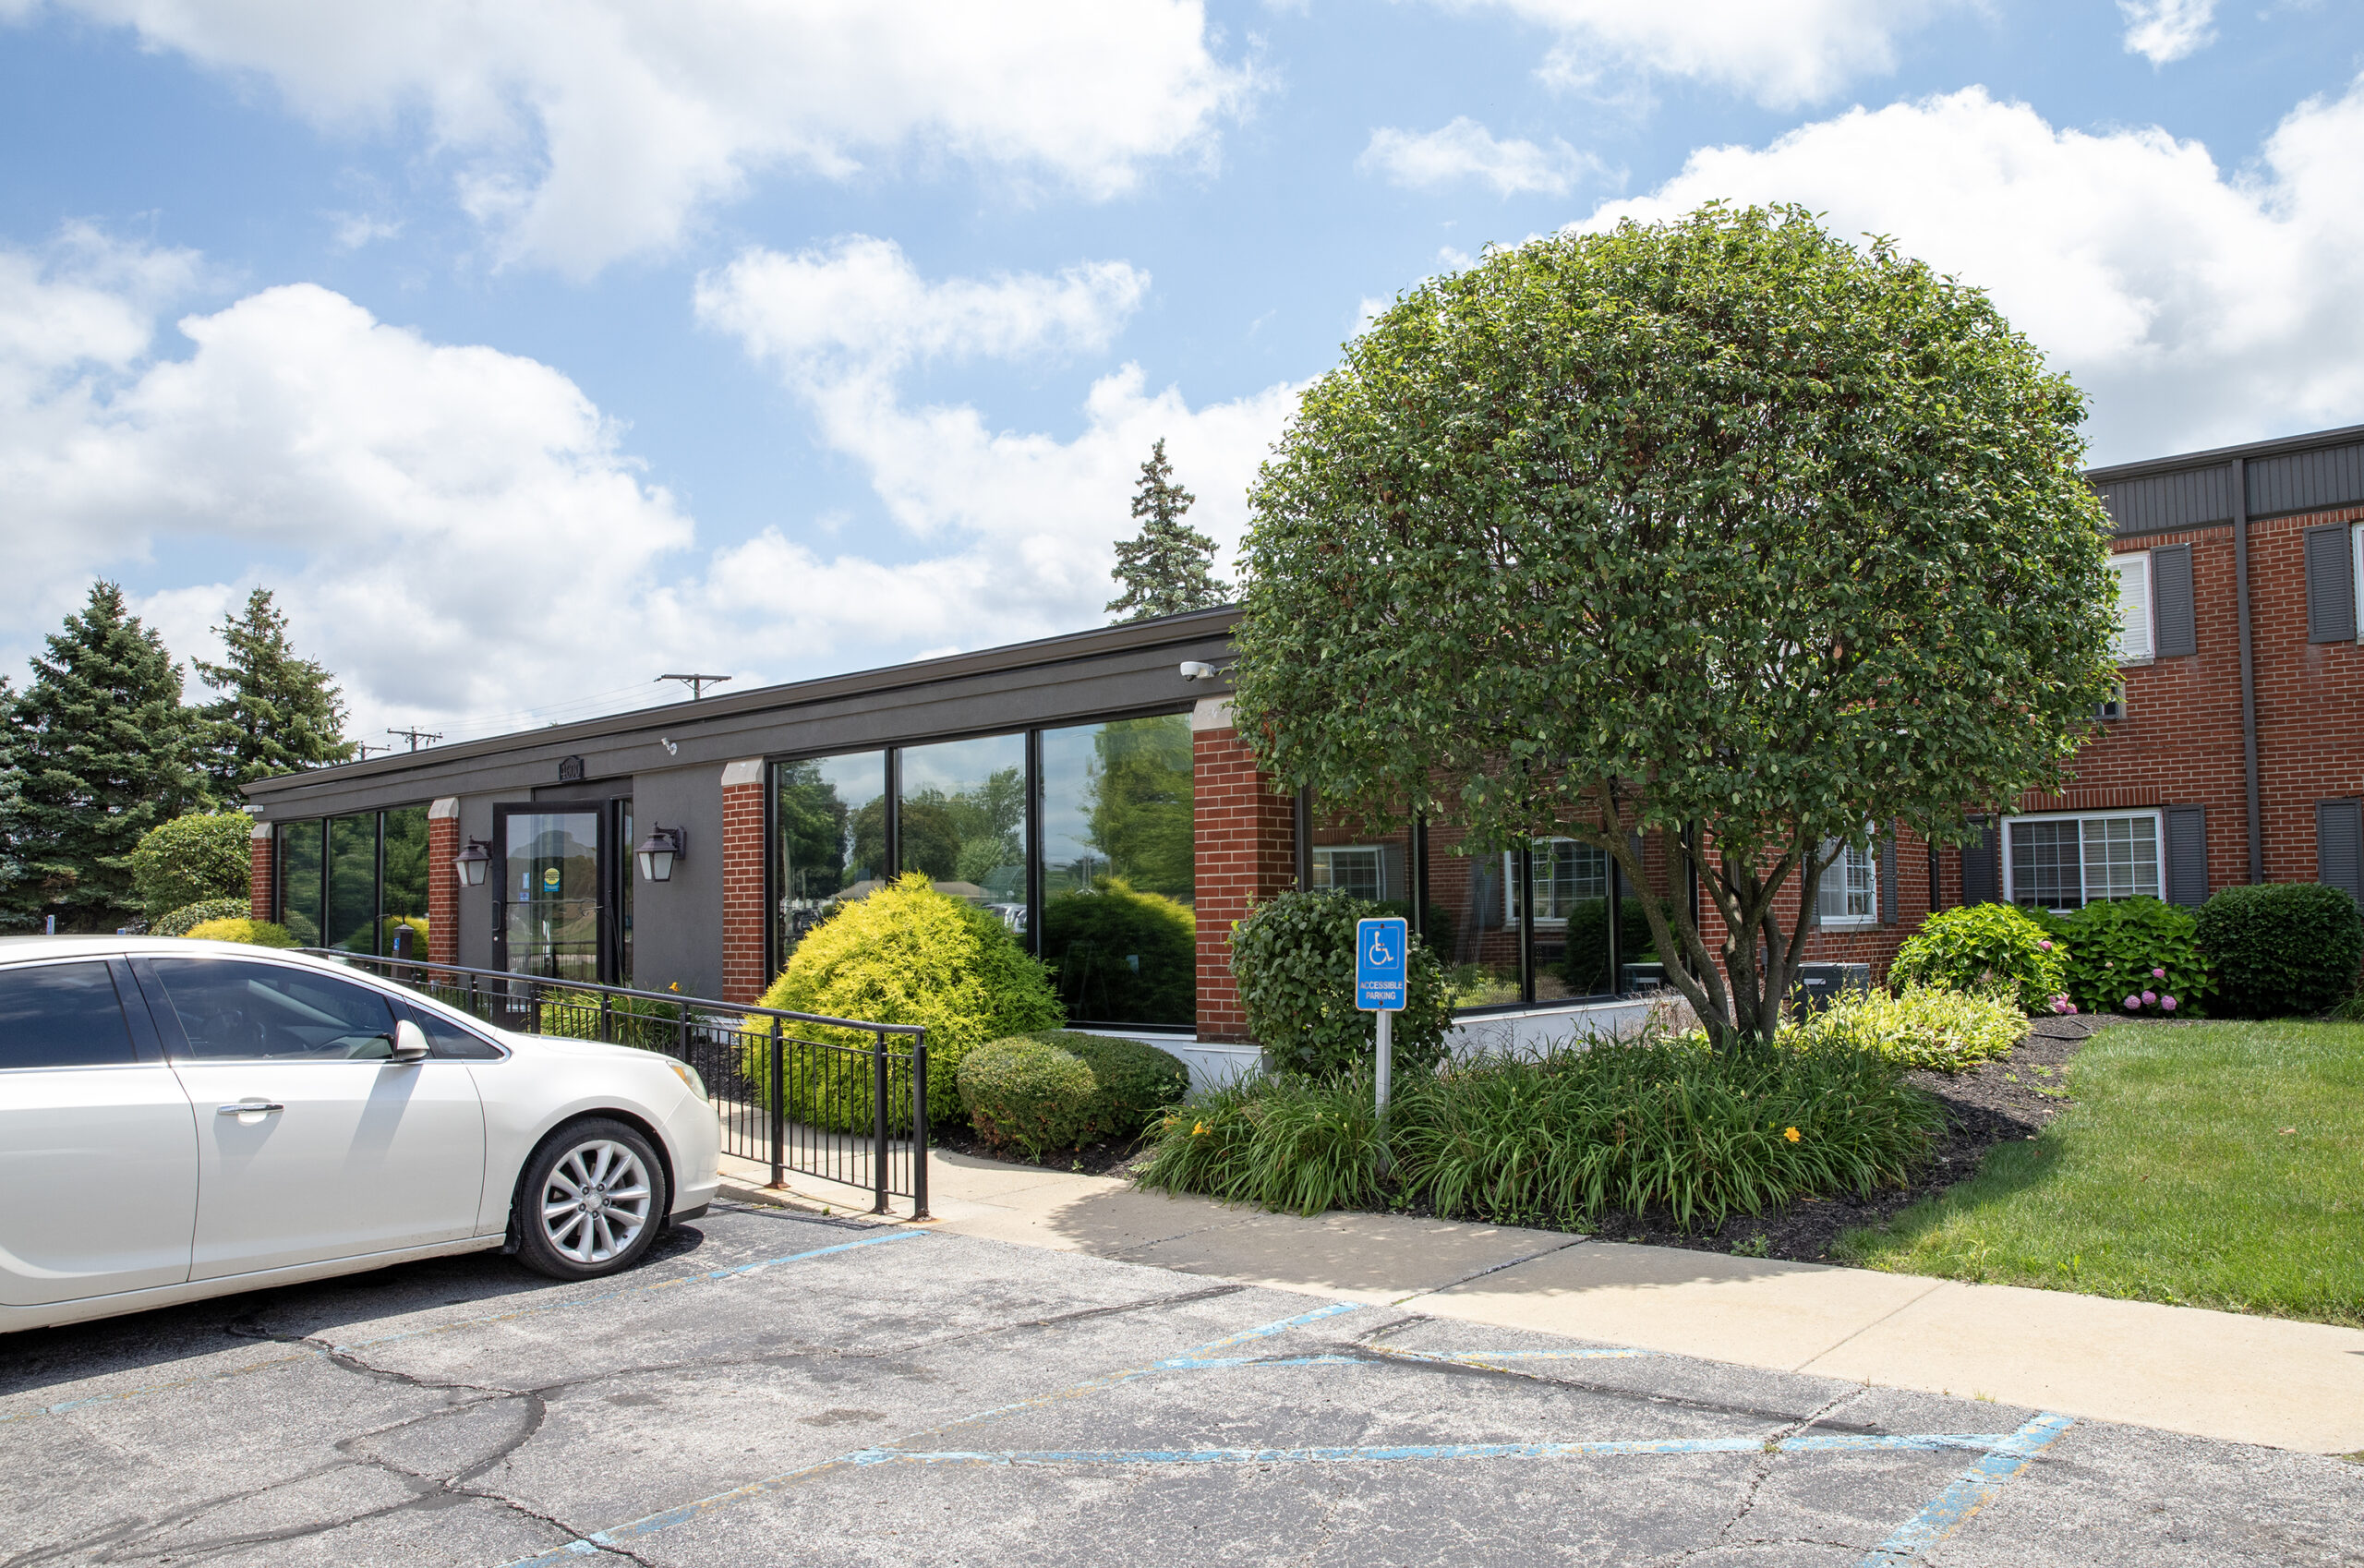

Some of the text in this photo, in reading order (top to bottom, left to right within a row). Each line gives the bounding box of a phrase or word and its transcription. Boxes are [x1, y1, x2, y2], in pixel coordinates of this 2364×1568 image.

[561, 764, 581, 778] 4600
[1360, 981, 1403, 990] ACCESSIBLE
[1366, 991, 1396, 1000] PARKING
